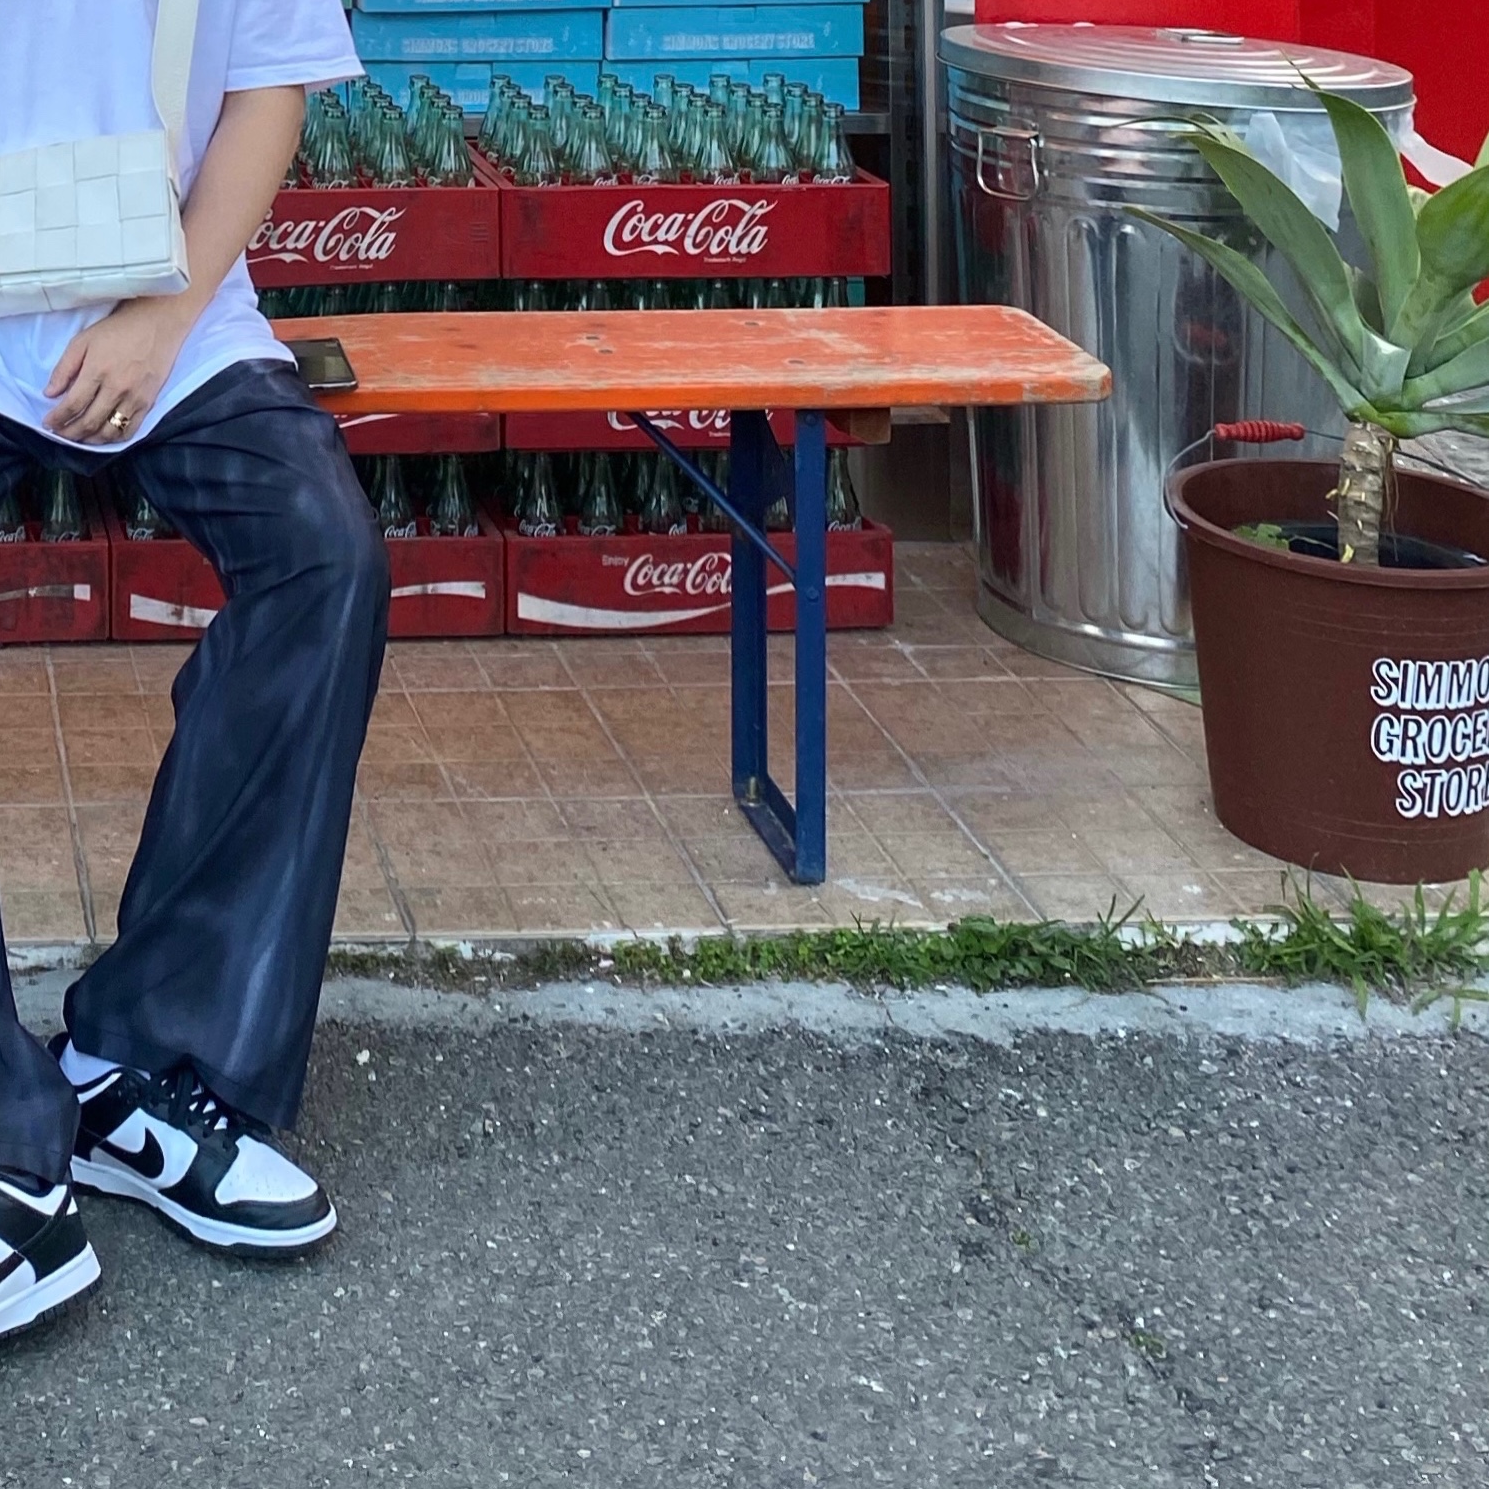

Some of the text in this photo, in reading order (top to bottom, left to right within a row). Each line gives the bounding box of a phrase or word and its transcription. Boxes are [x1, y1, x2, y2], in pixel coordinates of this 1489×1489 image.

[246, 206, 407, 263] oca-Cola
[603, 198, 779, 256] Coca-Cola
[602, 554, 629, 566] Enjoy
